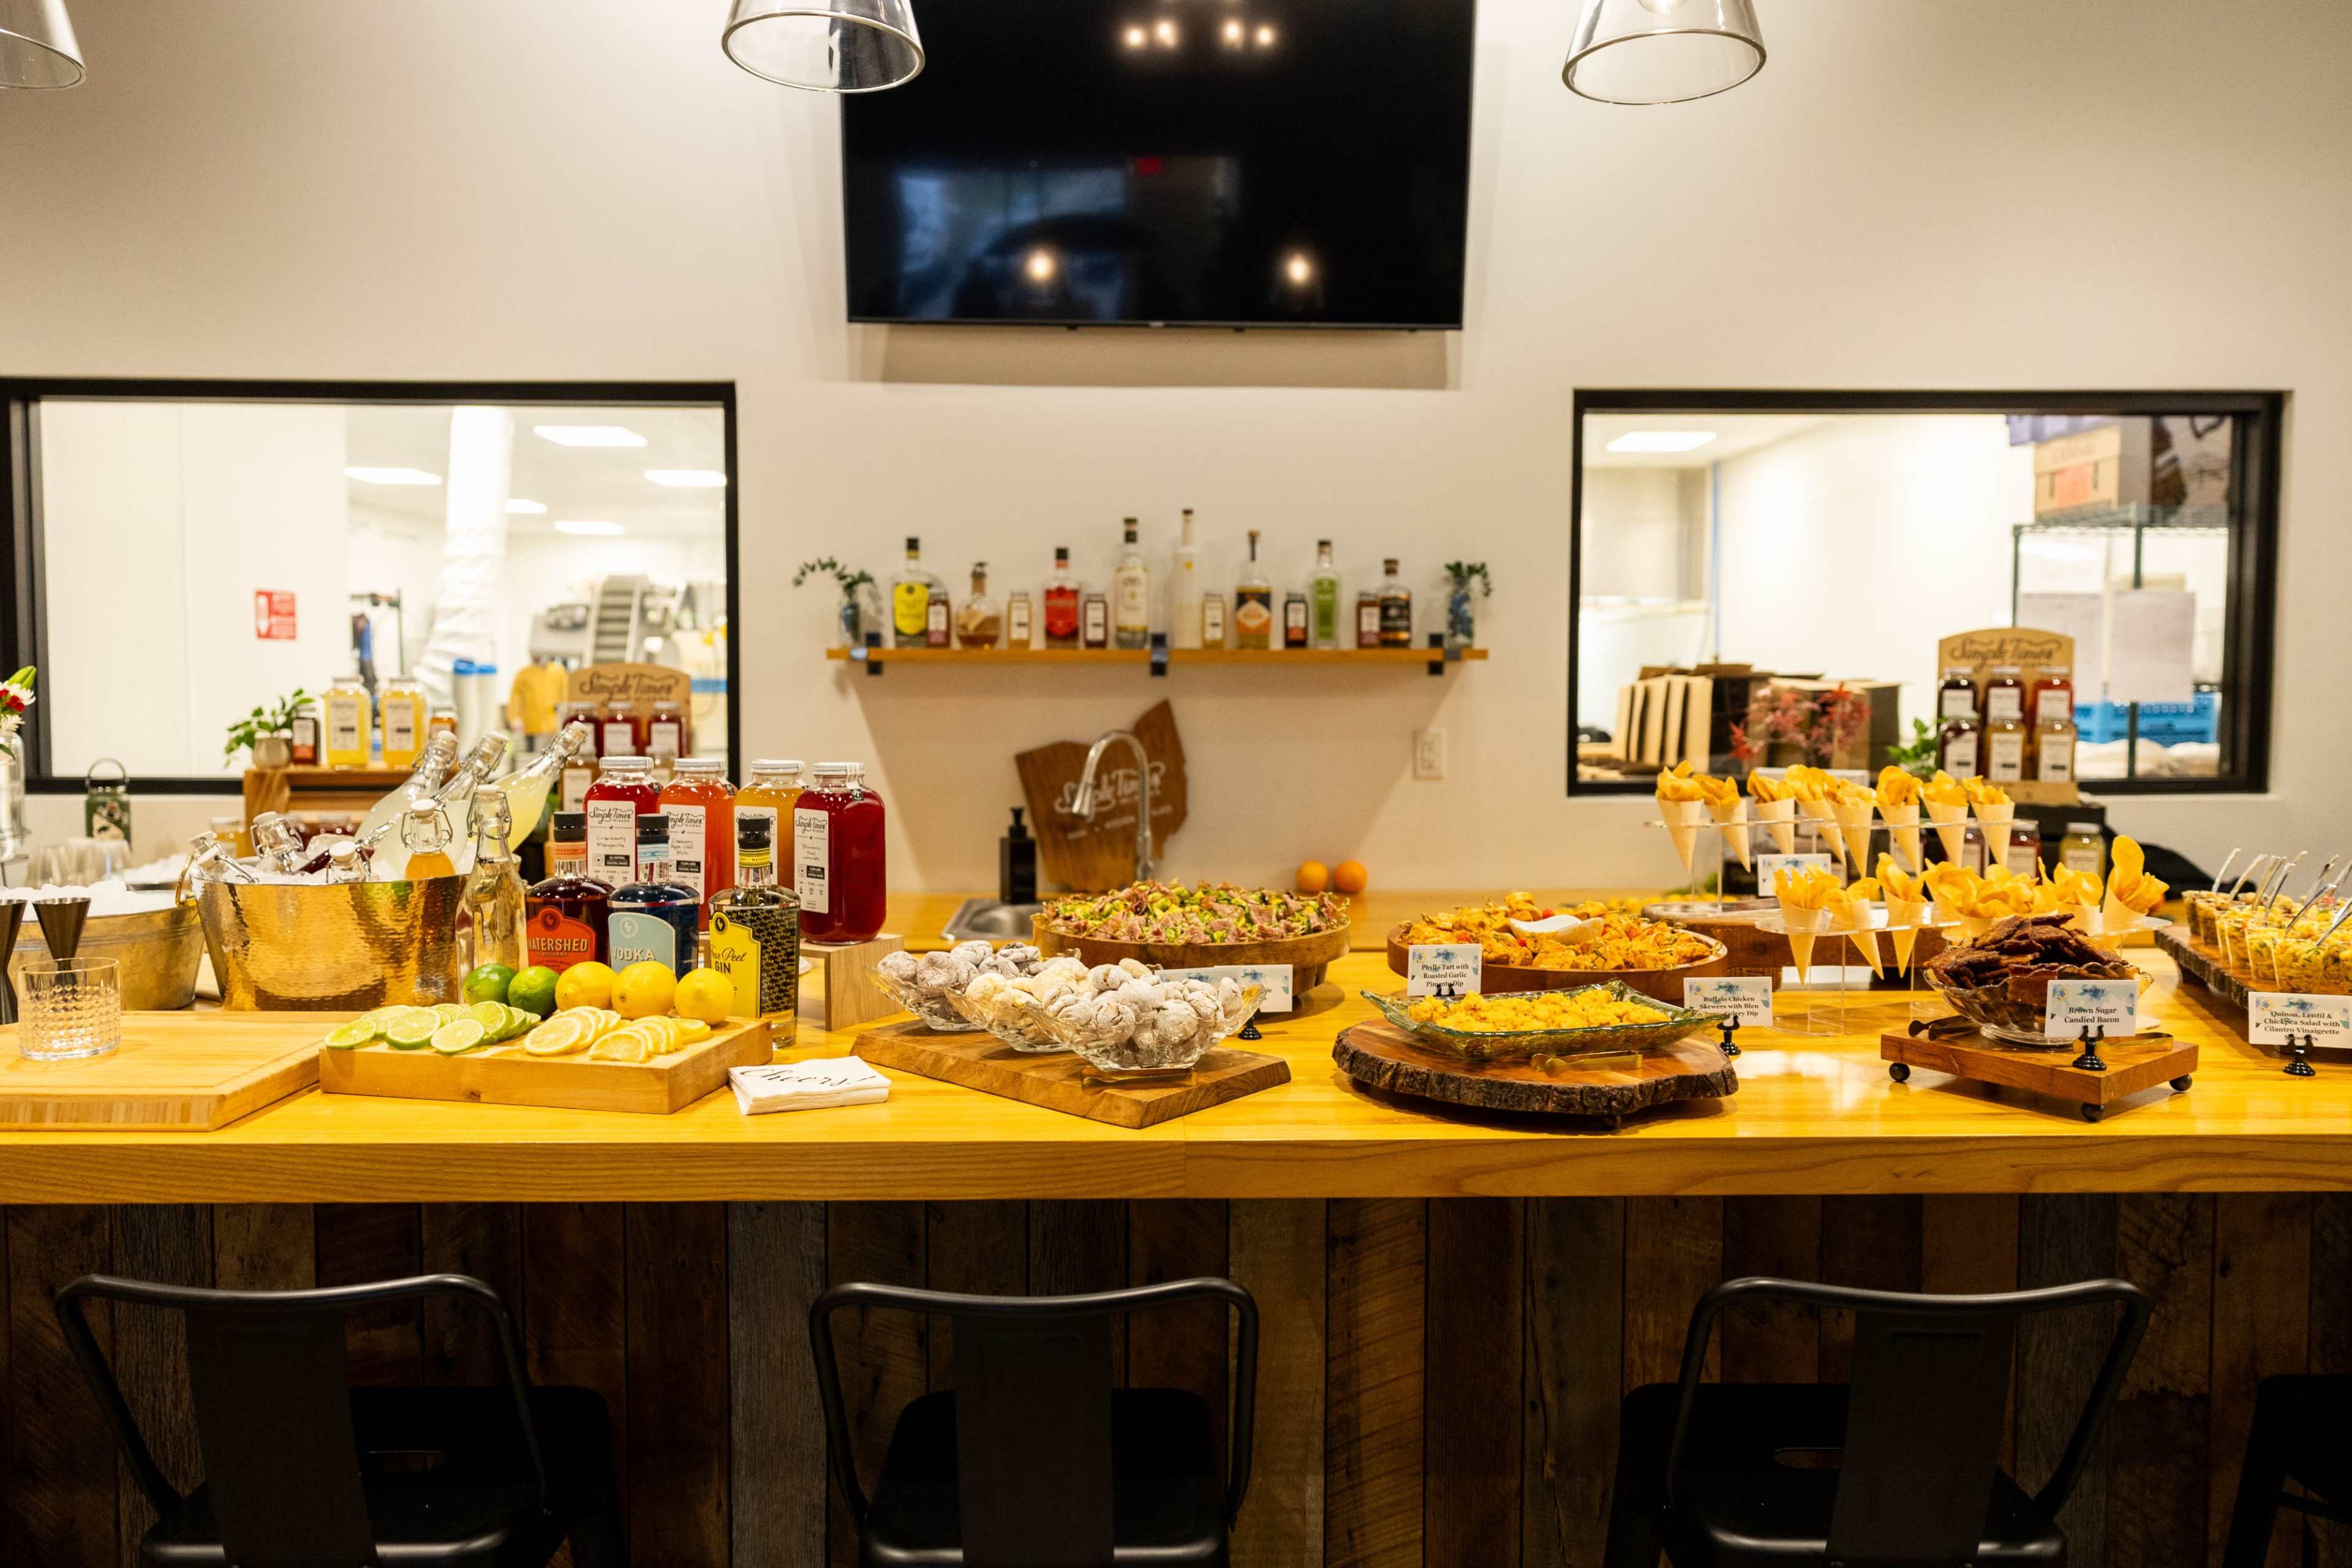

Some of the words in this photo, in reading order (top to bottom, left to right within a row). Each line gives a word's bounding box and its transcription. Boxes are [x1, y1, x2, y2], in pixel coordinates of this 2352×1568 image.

[589, 806, 612, 824] Simple
[612, 808, 634, 819] Times
[667, 811, 684, 829] mple
[684, 813, 705, 824] Times
[528, 937, 589, 952] WATERSHED
[612, 947, 656, 960] VODKA
[722, 947, 747, 962] Peel
[715, 961, 731, 974] GIN
[739, 1068, 876, 1087] Cheers!
